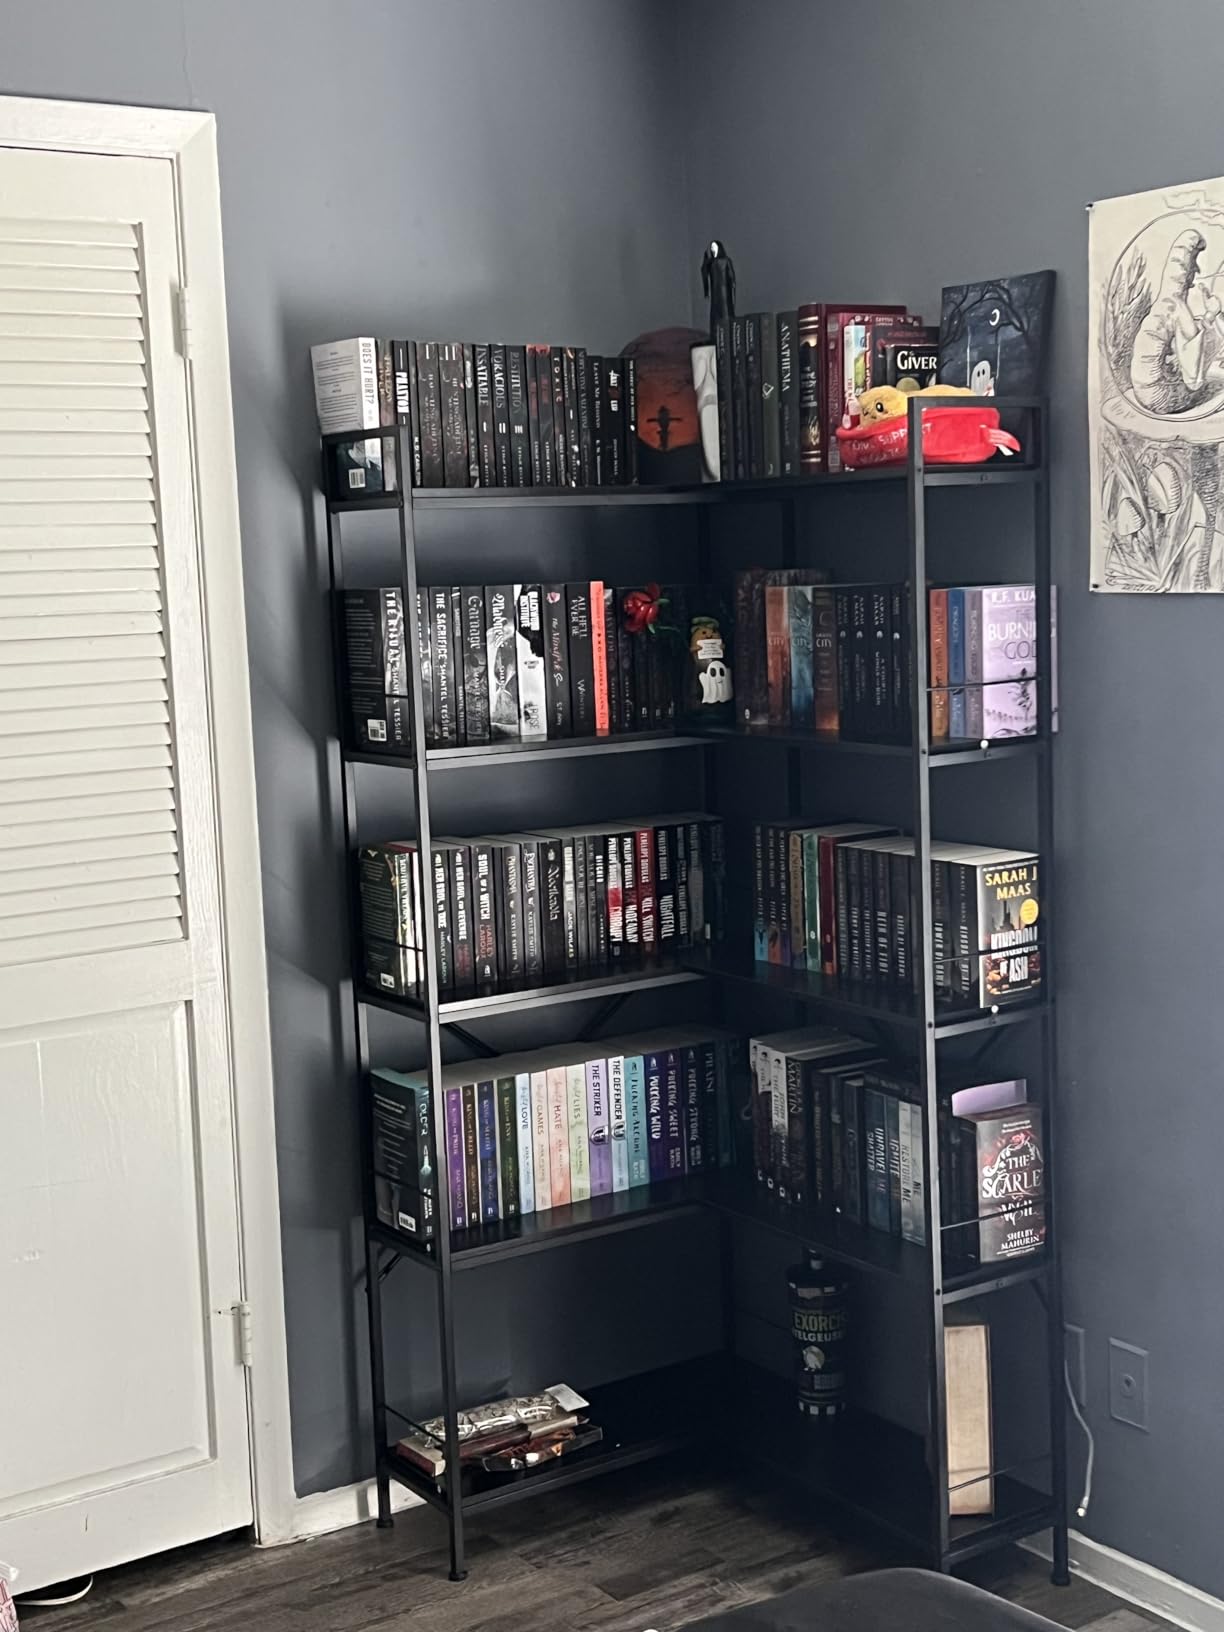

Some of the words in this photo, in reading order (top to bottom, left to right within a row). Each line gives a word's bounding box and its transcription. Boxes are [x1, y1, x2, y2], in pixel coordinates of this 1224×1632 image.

[362, 343, 372, 363] DOES
[781, 322, 791, 392] ANATHEMA
[477, 348, 488, 406] INSATIABLE
[493, 349, 505, 408] VORACIOUS
[510, 352, 522, 414] RESTITUTION
[554, 357, 562, 402] TOXIC
[364, 378, 374, 404] HURT?
[396, 372, 409, 413] PHANTOM
[386, 592, 396, 615] THE
[435, 593, 445, 609] THE
[577, 596, 585, 613] ALL
[1014, 591, 1036, 601] KUA
[491, 593, 505, 648] Madness
[571, 626, 579, 636] BE
[988, 621, 1036, 640] BURNI
[388, 620, 399, 663] RITUAL
[437, 613, 447, 660] SACRIFICE
[439, 663, 448, 701] SHANTEL
[393, 707, 401, 740] TESSIER
[441, 704, 449, 737] TESSIER
[608, 837, 618, 863] PENELOPE
[624, 837, 632, 863] PENELOPE
[640, 832, 649, 857] PENELOPE
[435, 868, 444, 883] HER
[456, 867, 464, 881] HER
[478, 854, 488, 878] SOUL
[641, 859, 649, 883] DOUGLAS
[985, 867, 1027, 886] SARAH
[435, 884, 445, 903] SOUL
[456, 882, 465, 900] SOUL
[996, 883, 1032, 900] MAAS
[480, 894, 490, 920] WITCH
[641, 897, 653, 913] KILL
[659, 895, 675, 939] NIGHTFALL
[458, 910, 467, 940] REVENGE
[609, 907, 623, 942] CORRUPT
[625, 904, 638, 943] HIDEAWAY
[642, 915, 654, 942] SWITCH
[935, 922, 943, 948] TOWER
[878, 937, 888, 948] OF
[1009, 956, 1029, 983] ASH
[592, 1065, 600, 1080] THE
[613, 1060, 621, 1075] THE
[593, 1082, 602, 1116] STRIKER
[614, 1077, 622, 1120] DEFENDER
[787, 1060, 796, 1114] MARTIN
[536, 1105, 544, 1135] GAMES
[651, 1115, 662, 1139] WILD
[669, 1109, 678, 1137] SWEET
[1006, 1155, 1029, 1170] THE
[902, 1188, 911, 1203] ME
[982, 1169, 1043, 1198] SCARLE
[1001, 1235, 1039, 1250] MAHURIN
[1007, 1228, 1033, 1241] SHELBY
